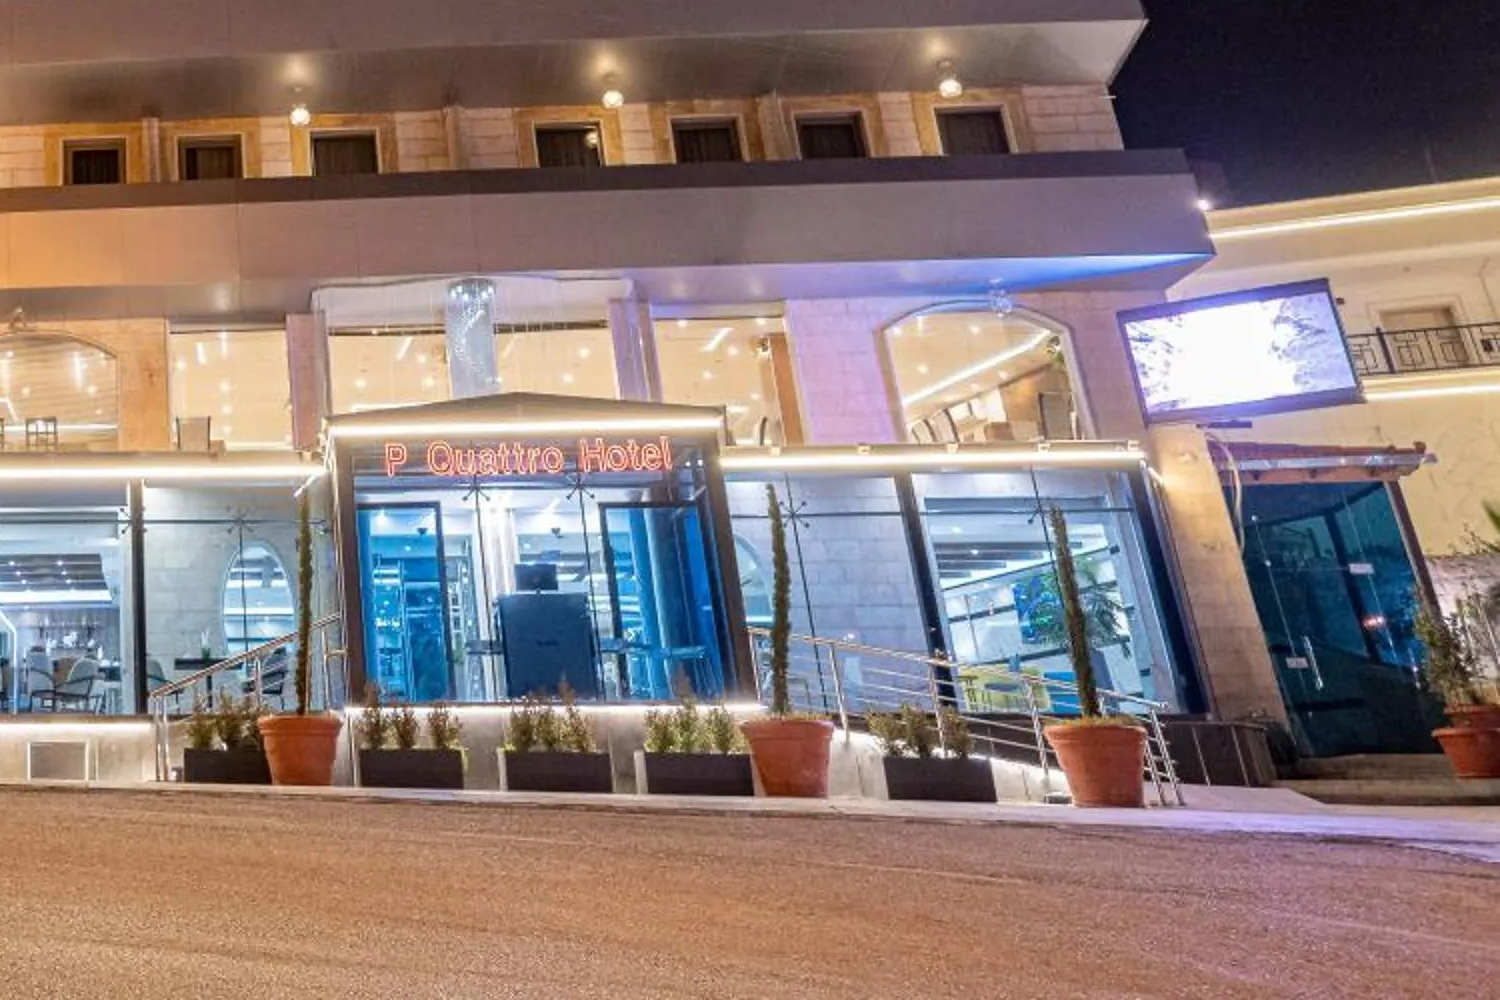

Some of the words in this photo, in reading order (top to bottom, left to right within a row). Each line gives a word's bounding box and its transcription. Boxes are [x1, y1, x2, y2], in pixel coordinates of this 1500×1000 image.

[384, 443, 406, 477] P
[426, 440, 564, 476] Quattro
[580, 435, 673, 472] Hotel
